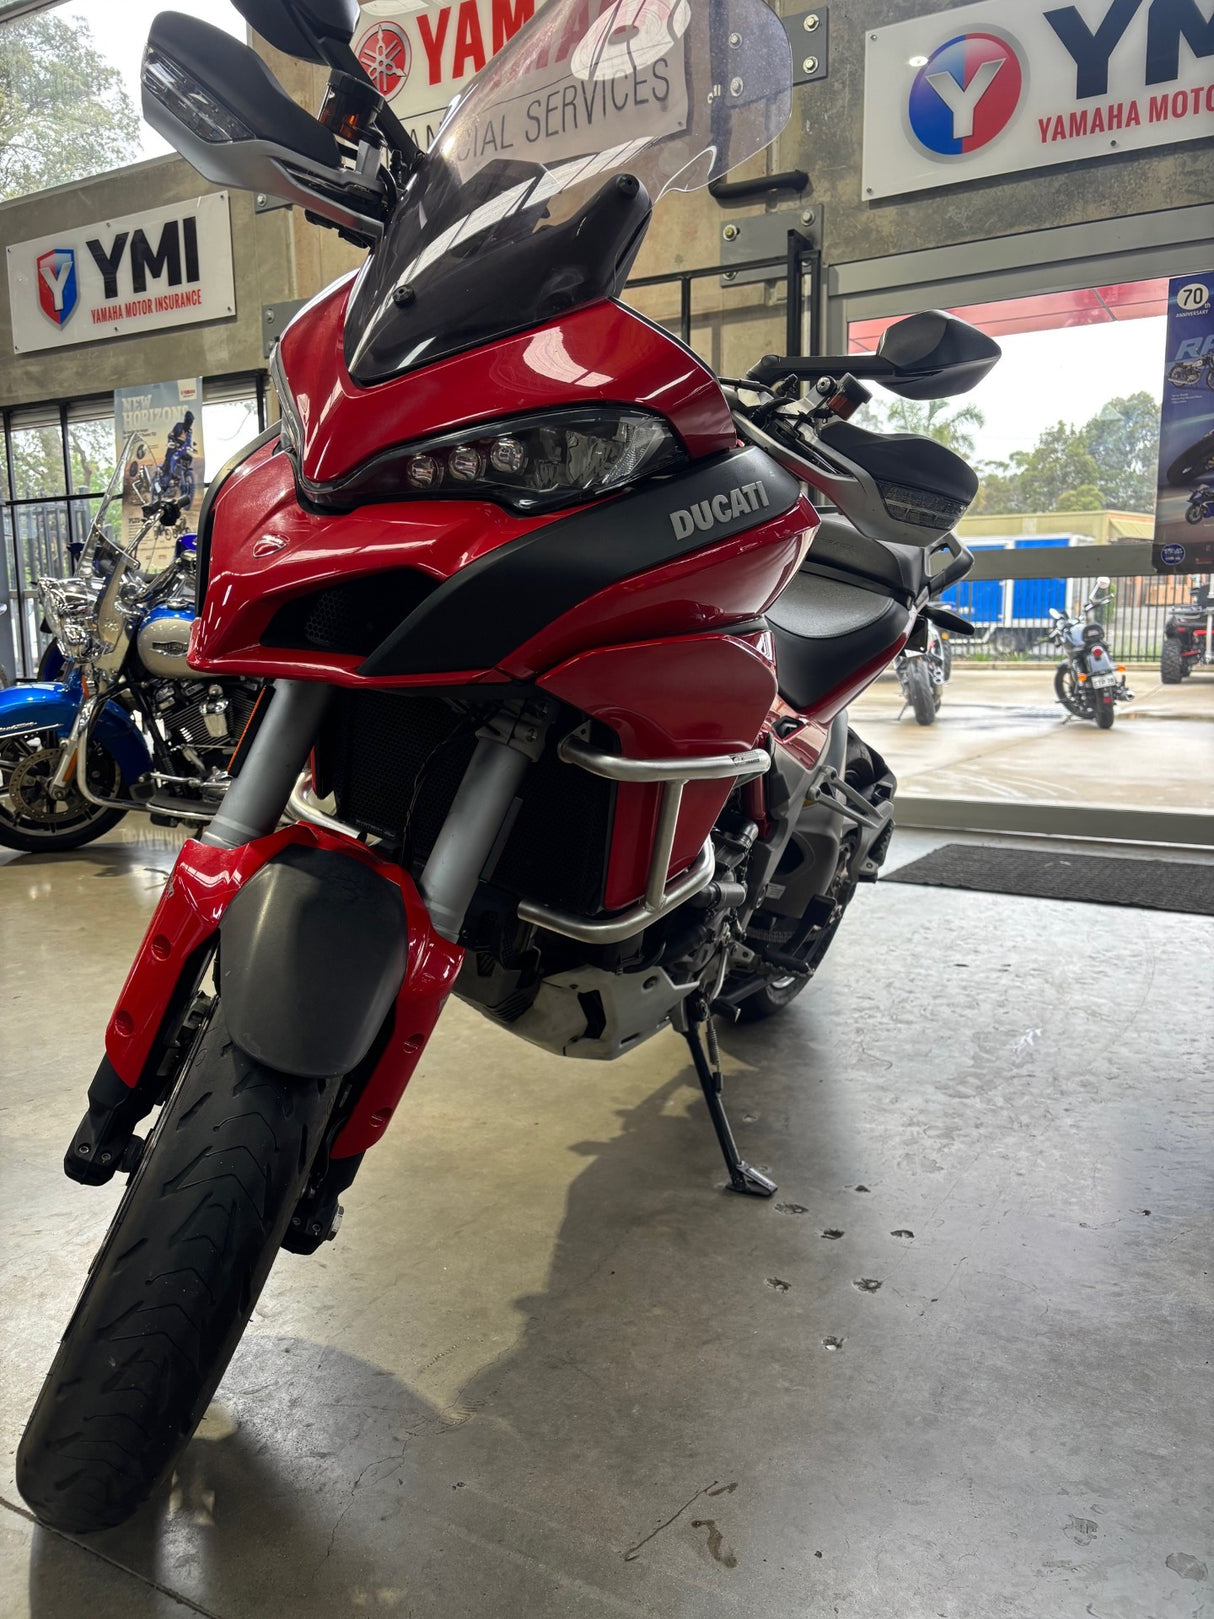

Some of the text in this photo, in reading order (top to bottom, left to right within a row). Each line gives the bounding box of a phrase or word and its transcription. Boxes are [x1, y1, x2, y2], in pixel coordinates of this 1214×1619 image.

[525, 58, 670, 143] SERVICES
[1038, 100, 1141, 144] YAMAHA
[86, 216, 200, 299] YMI
[91, 289, 202, 324] YAMAHA MOTOR INSURANCE
[1183, 287, 1203, 306] 70
[669, 480, 770, 541] DUCATI
